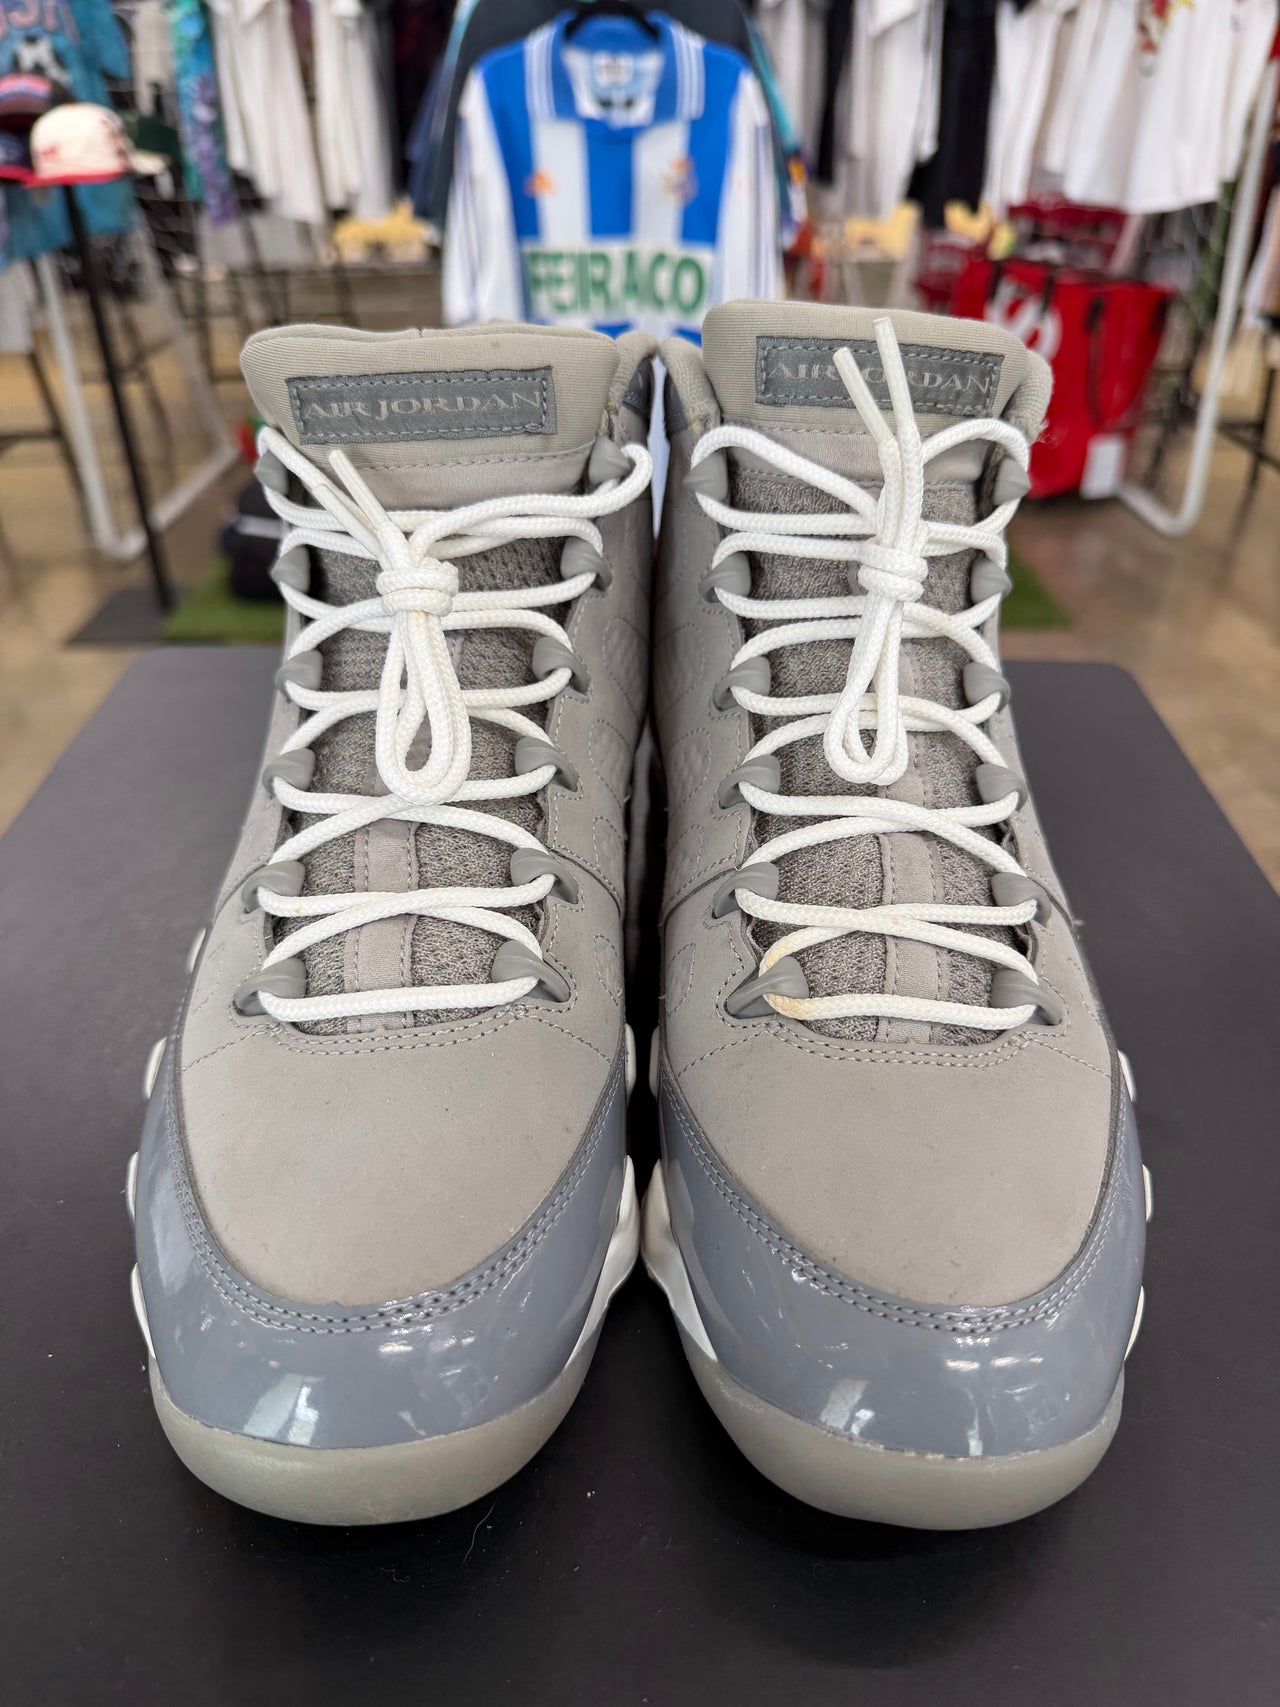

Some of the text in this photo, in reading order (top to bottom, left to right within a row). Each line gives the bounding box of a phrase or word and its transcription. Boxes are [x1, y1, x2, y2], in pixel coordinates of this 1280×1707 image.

[527, 250, 706, 315] FEIRACO
[769, 362, 839, 380] AIR
[304, 391, 542, 421] AIR JORDAN
